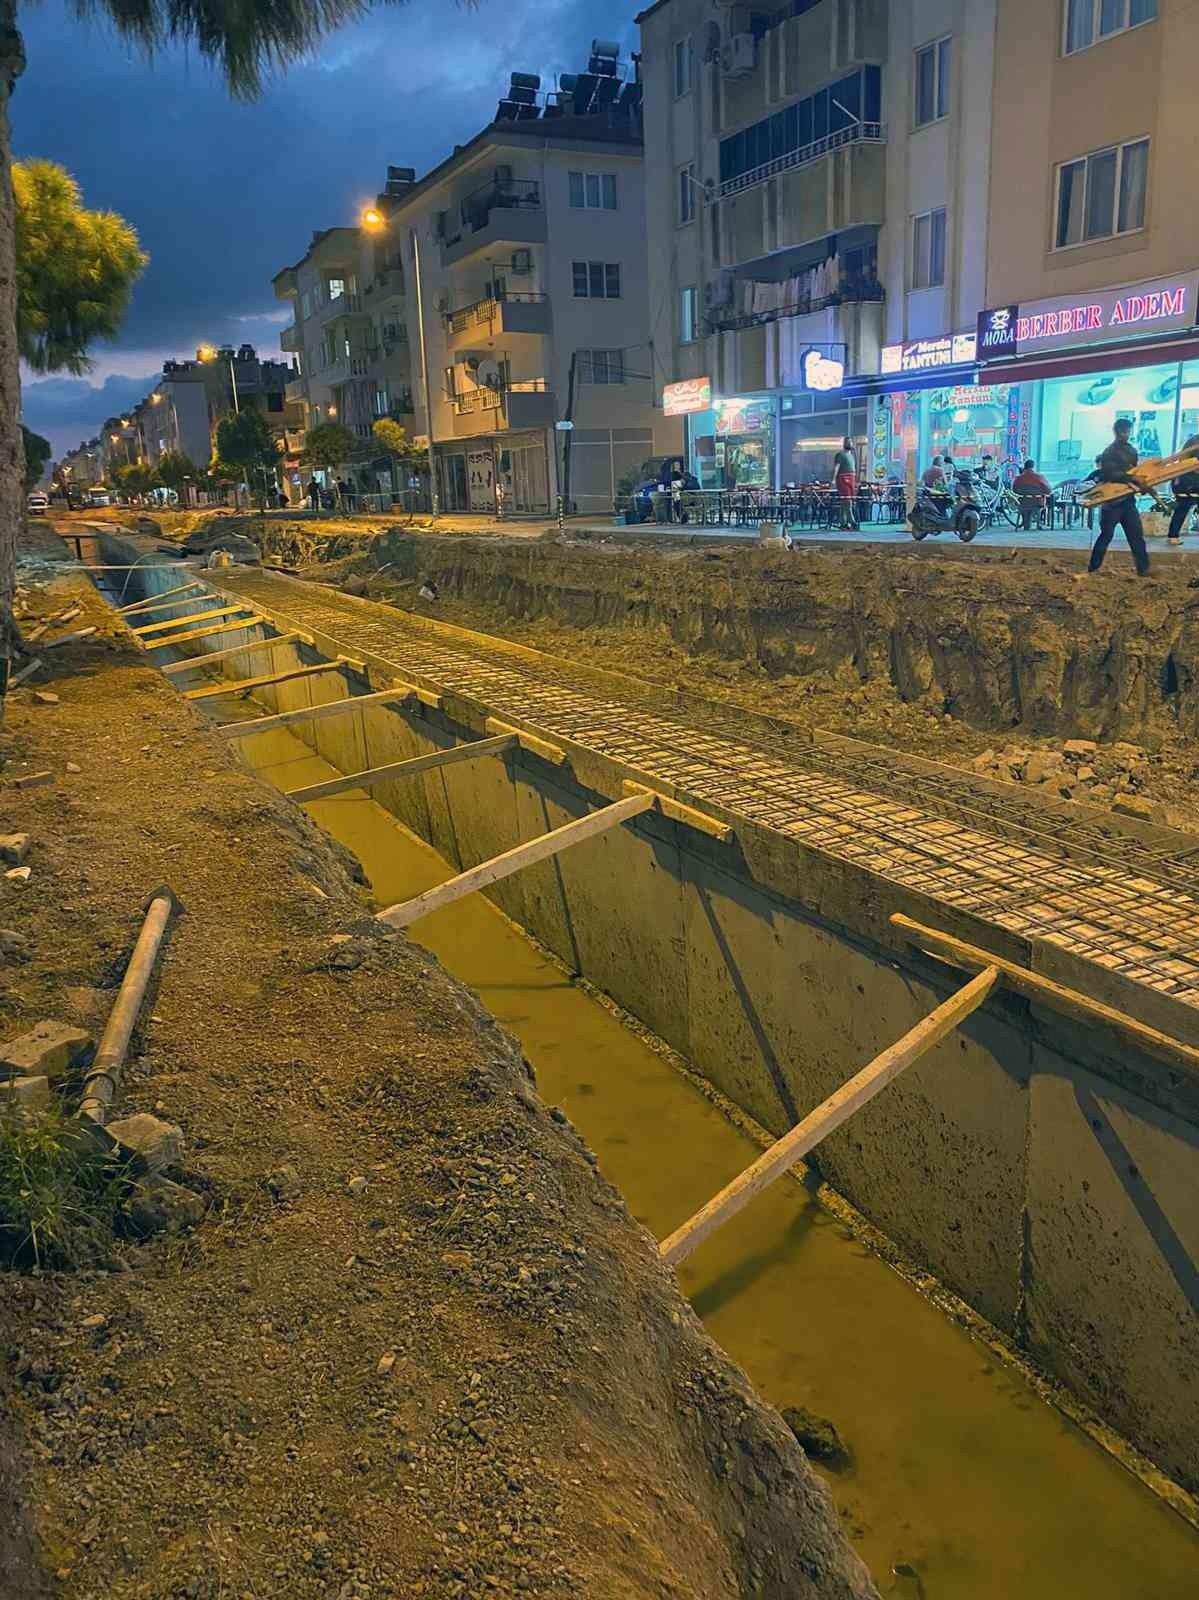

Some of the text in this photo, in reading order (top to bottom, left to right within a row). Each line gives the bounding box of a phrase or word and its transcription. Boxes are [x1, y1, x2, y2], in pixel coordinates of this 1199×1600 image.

[1015, 287, 1186, 341] BERBER ADEM
[982, 328, 1014, 347] MODA
